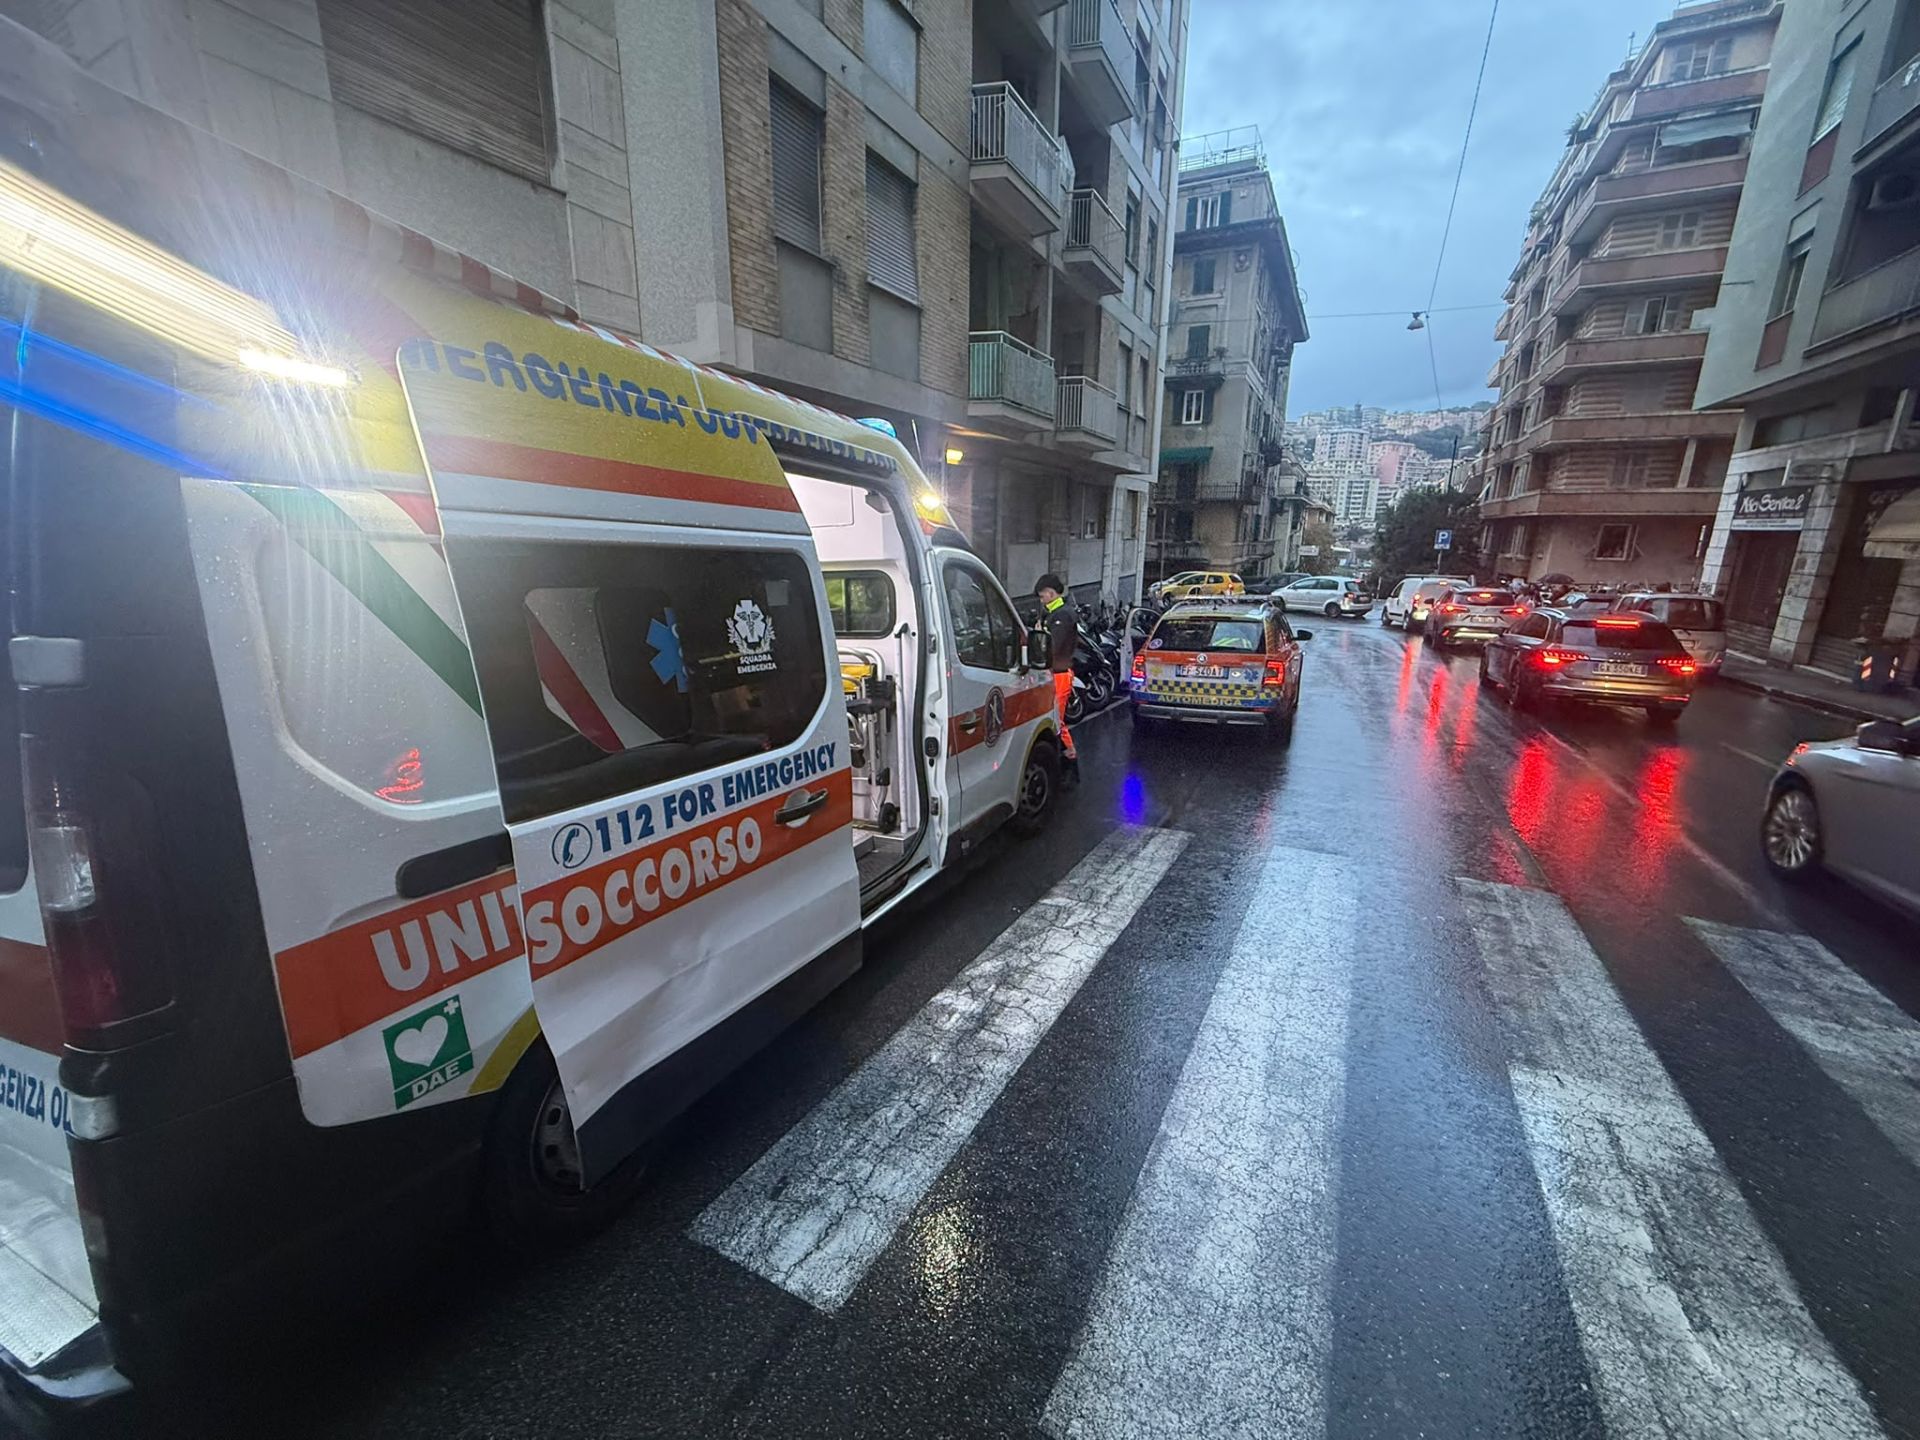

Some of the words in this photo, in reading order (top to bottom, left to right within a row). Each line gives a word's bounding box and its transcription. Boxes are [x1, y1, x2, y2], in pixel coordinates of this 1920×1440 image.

[1438, 531, 1449, 543] P
[737, 664, 777, 674] EMERGENZA
[739, 654, 772, 664] SQUADRA
[595, 803, 655, 853] 112
[663, 787, 718, 829] FOR
[723, 743, 837, 807] EMERGENCY
[525, 815, 763, 965] SOCCORSO
[411, 1061, 461, 1101] DAE
